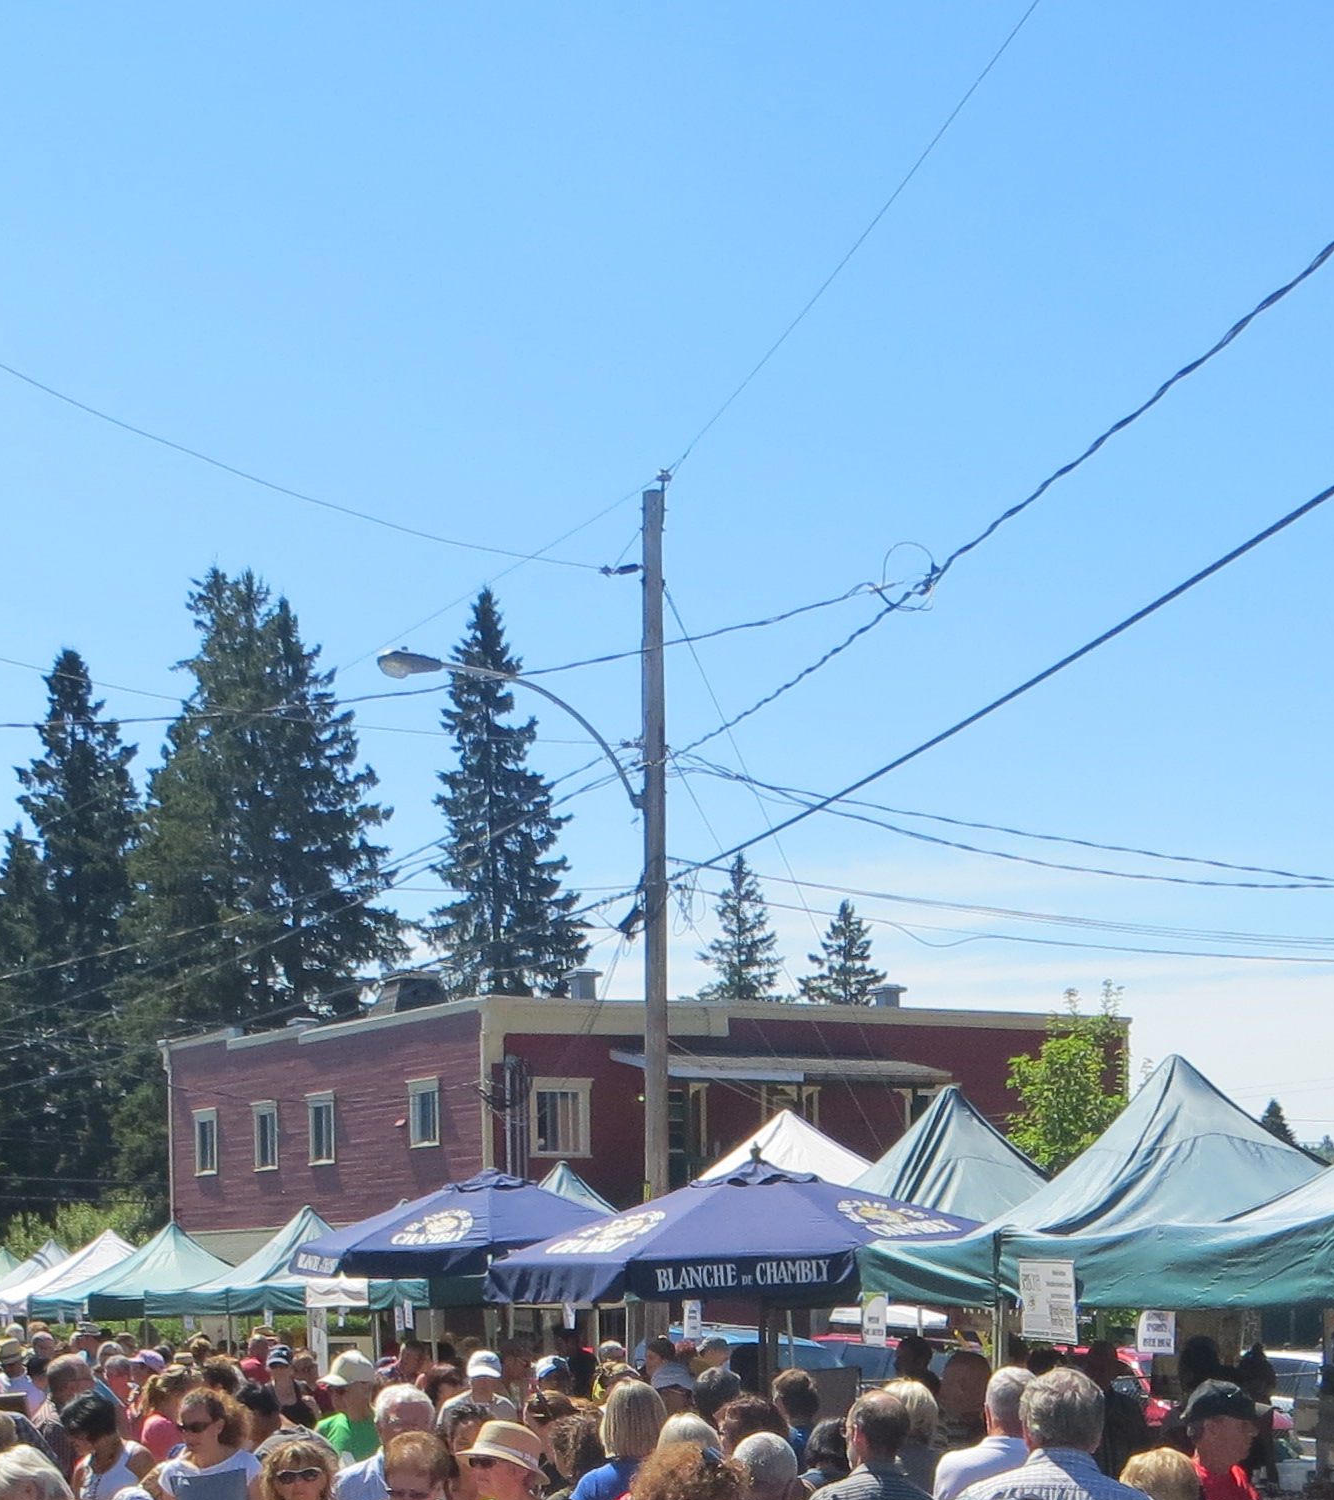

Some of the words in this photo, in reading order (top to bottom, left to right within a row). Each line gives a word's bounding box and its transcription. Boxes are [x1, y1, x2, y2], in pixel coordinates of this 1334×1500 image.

[390, 1230, 468, 1246] CHAMBLY
[655, 1263, 737, 1292] BLANCHE
[755, 1259, 830, 1285] CHAMBLY
